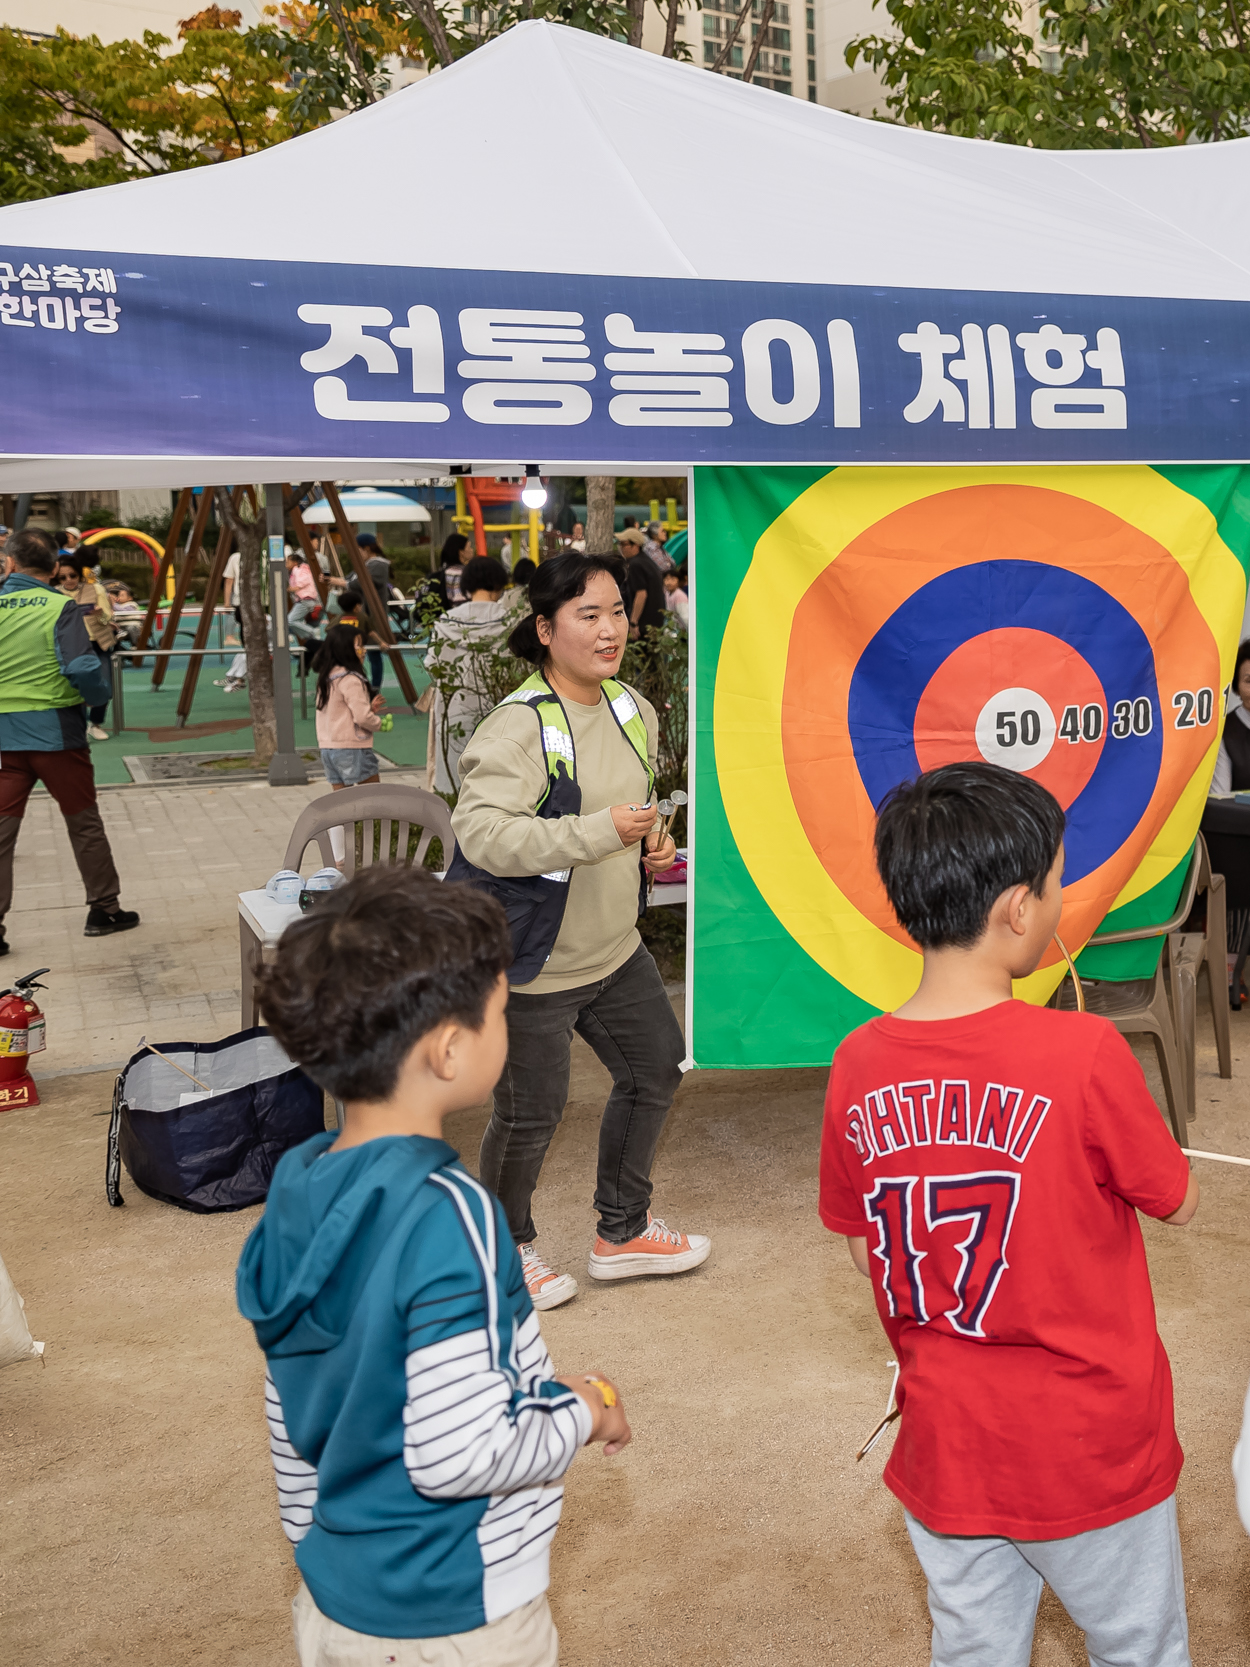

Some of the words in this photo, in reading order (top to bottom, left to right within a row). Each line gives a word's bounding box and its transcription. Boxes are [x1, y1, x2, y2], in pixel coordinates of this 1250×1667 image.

[0, 262, 117, 294] 구삼축제
[0, 292, 122, 334] 한마당
[297, 303, 862, 428] 전통놀이
[897, 320, 1128, 430] 체험
[995, 709, 1041, 748] 50
[1058, 703, 1104, 744] 40
[1112, 696, 1153, 739] 30
[1172, 687, 1214, 730] 20
[846, 1079, 1052, 1167] OHTANI
[863, 1170, 1021, 1338] 17
